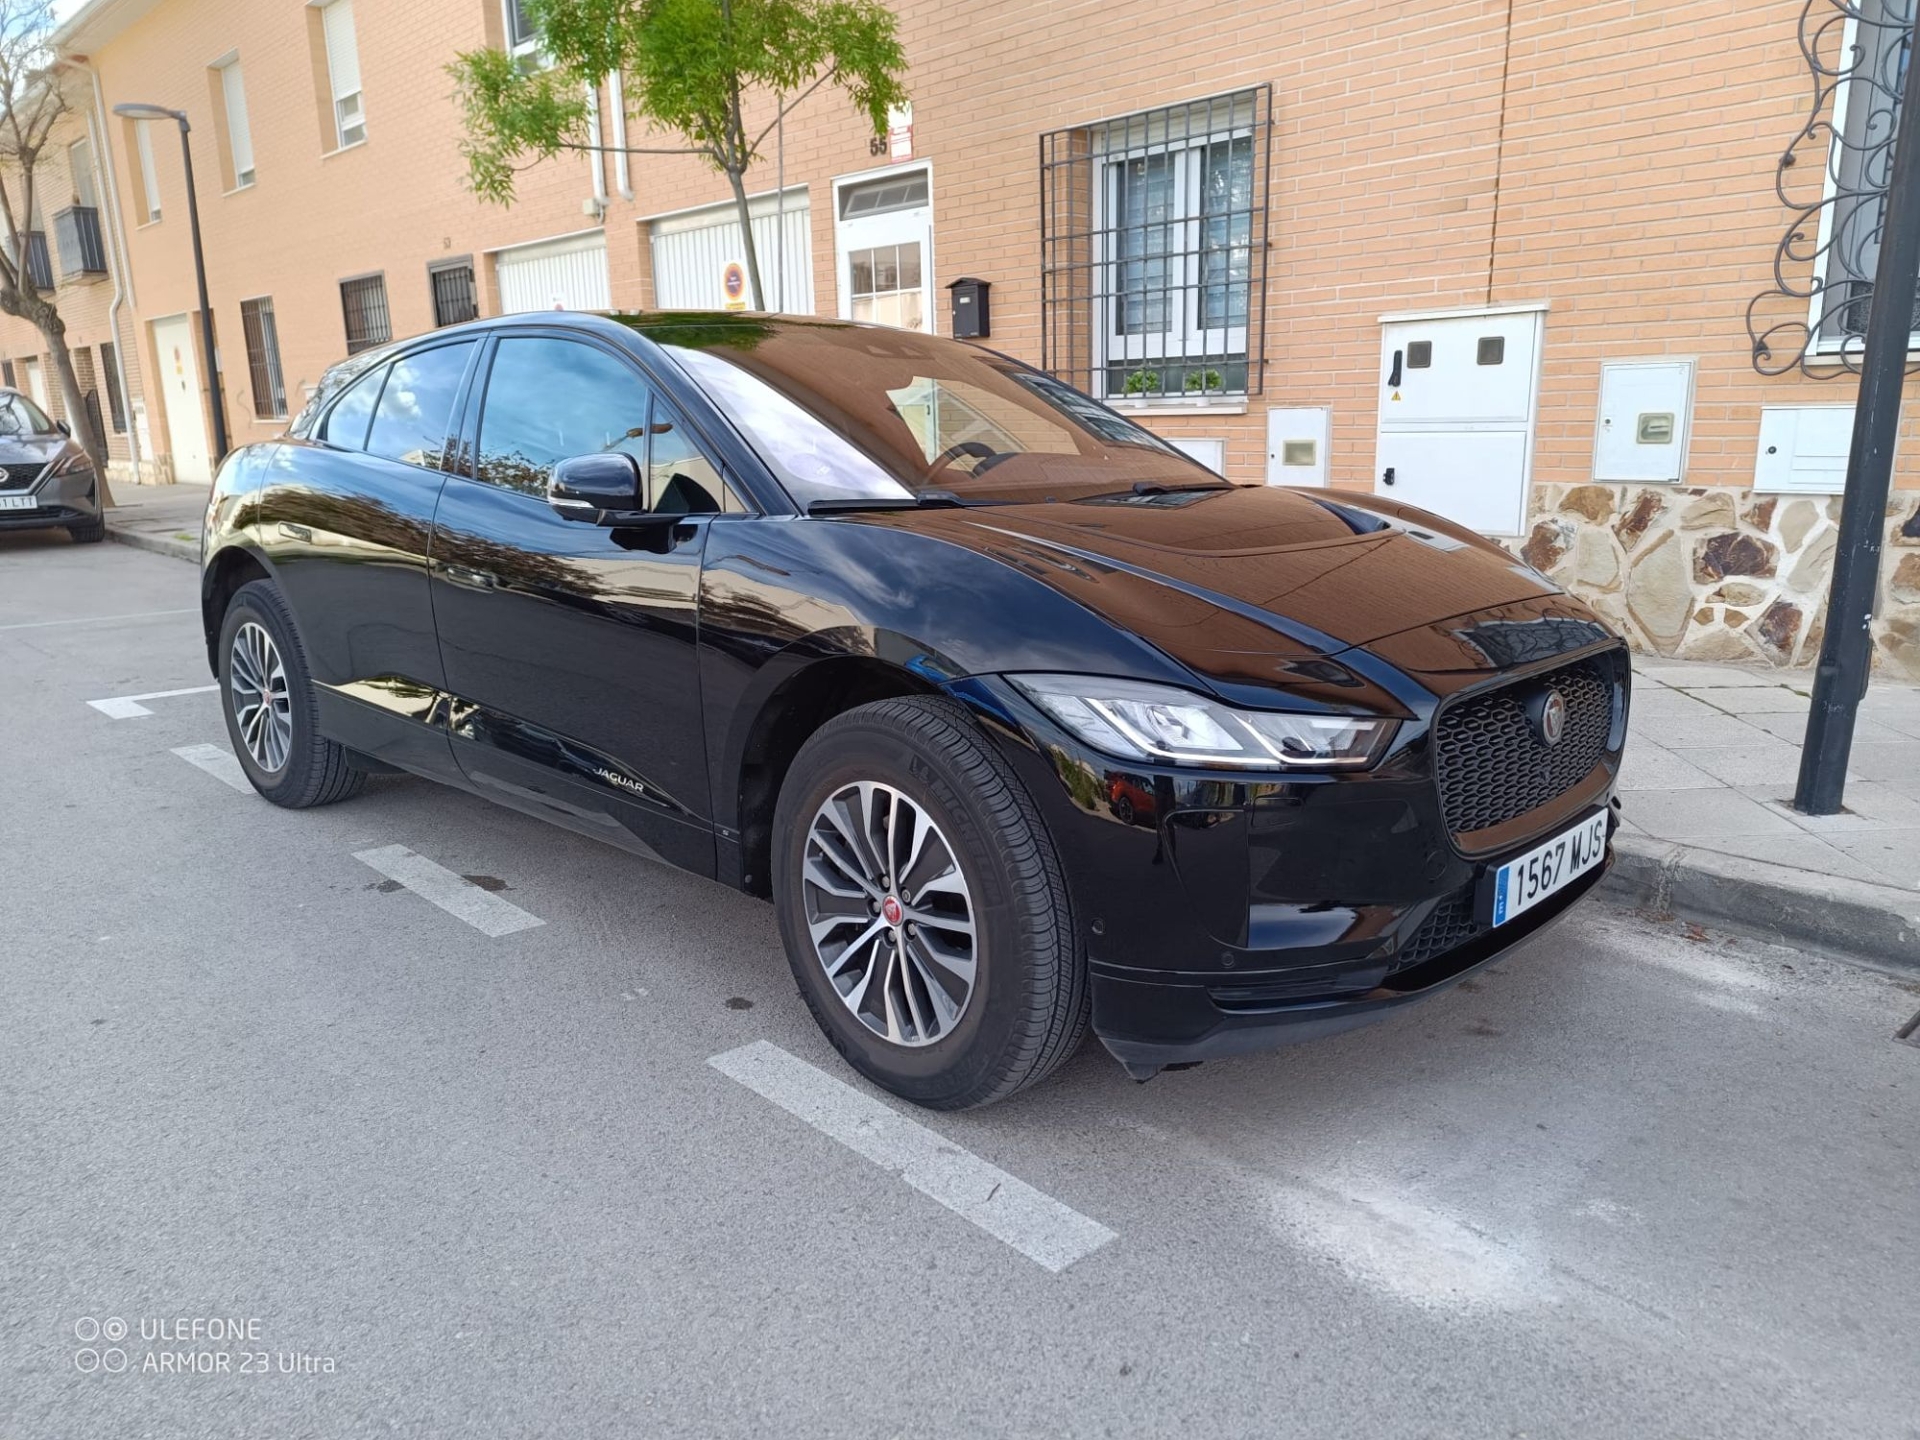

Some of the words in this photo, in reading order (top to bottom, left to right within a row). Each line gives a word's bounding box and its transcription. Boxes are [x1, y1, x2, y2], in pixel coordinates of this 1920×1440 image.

[12, 497, 32, 507] LTT
[592, 767, 645, 793] JAGUAR
[1517, 840, 1566, 906] 1567
[1569, 819, 1603, 874] MJS
